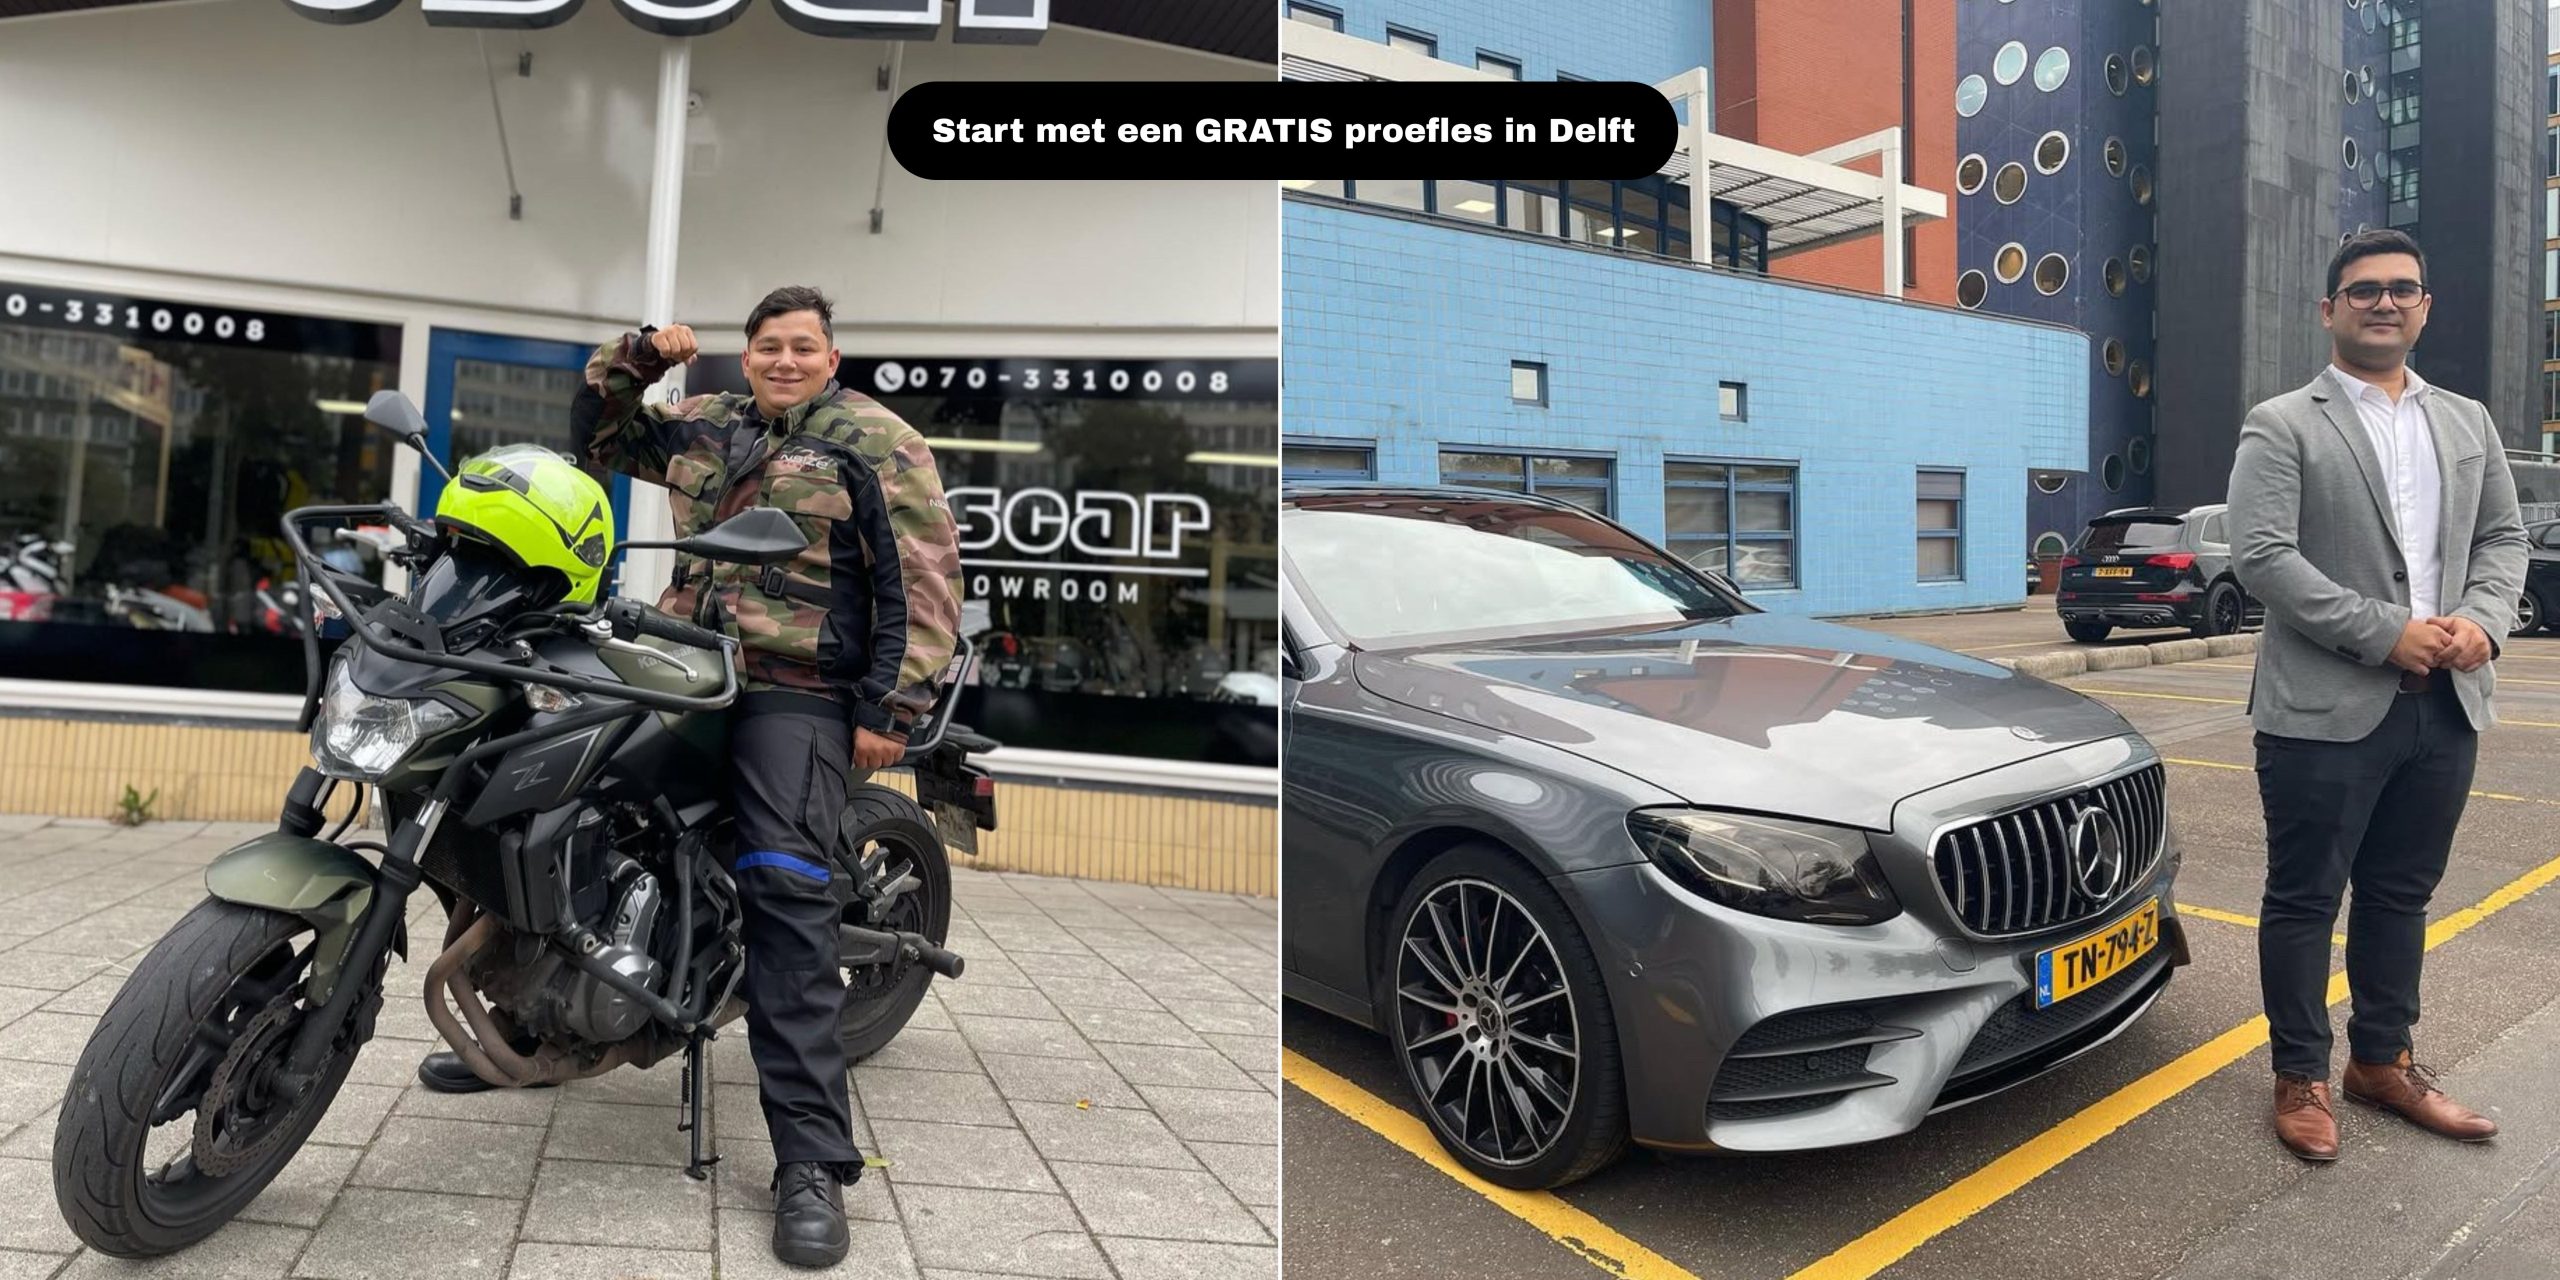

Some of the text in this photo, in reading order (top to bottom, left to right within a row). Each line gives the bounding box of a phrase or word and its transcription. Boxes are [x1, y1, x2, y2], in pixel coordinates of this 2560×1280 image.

[6, 293, 265, 342] 0-3310008
[909, 366, 1229, 393] 070-3310008
[2063, 910, 2155, 989] TN-794-Z
